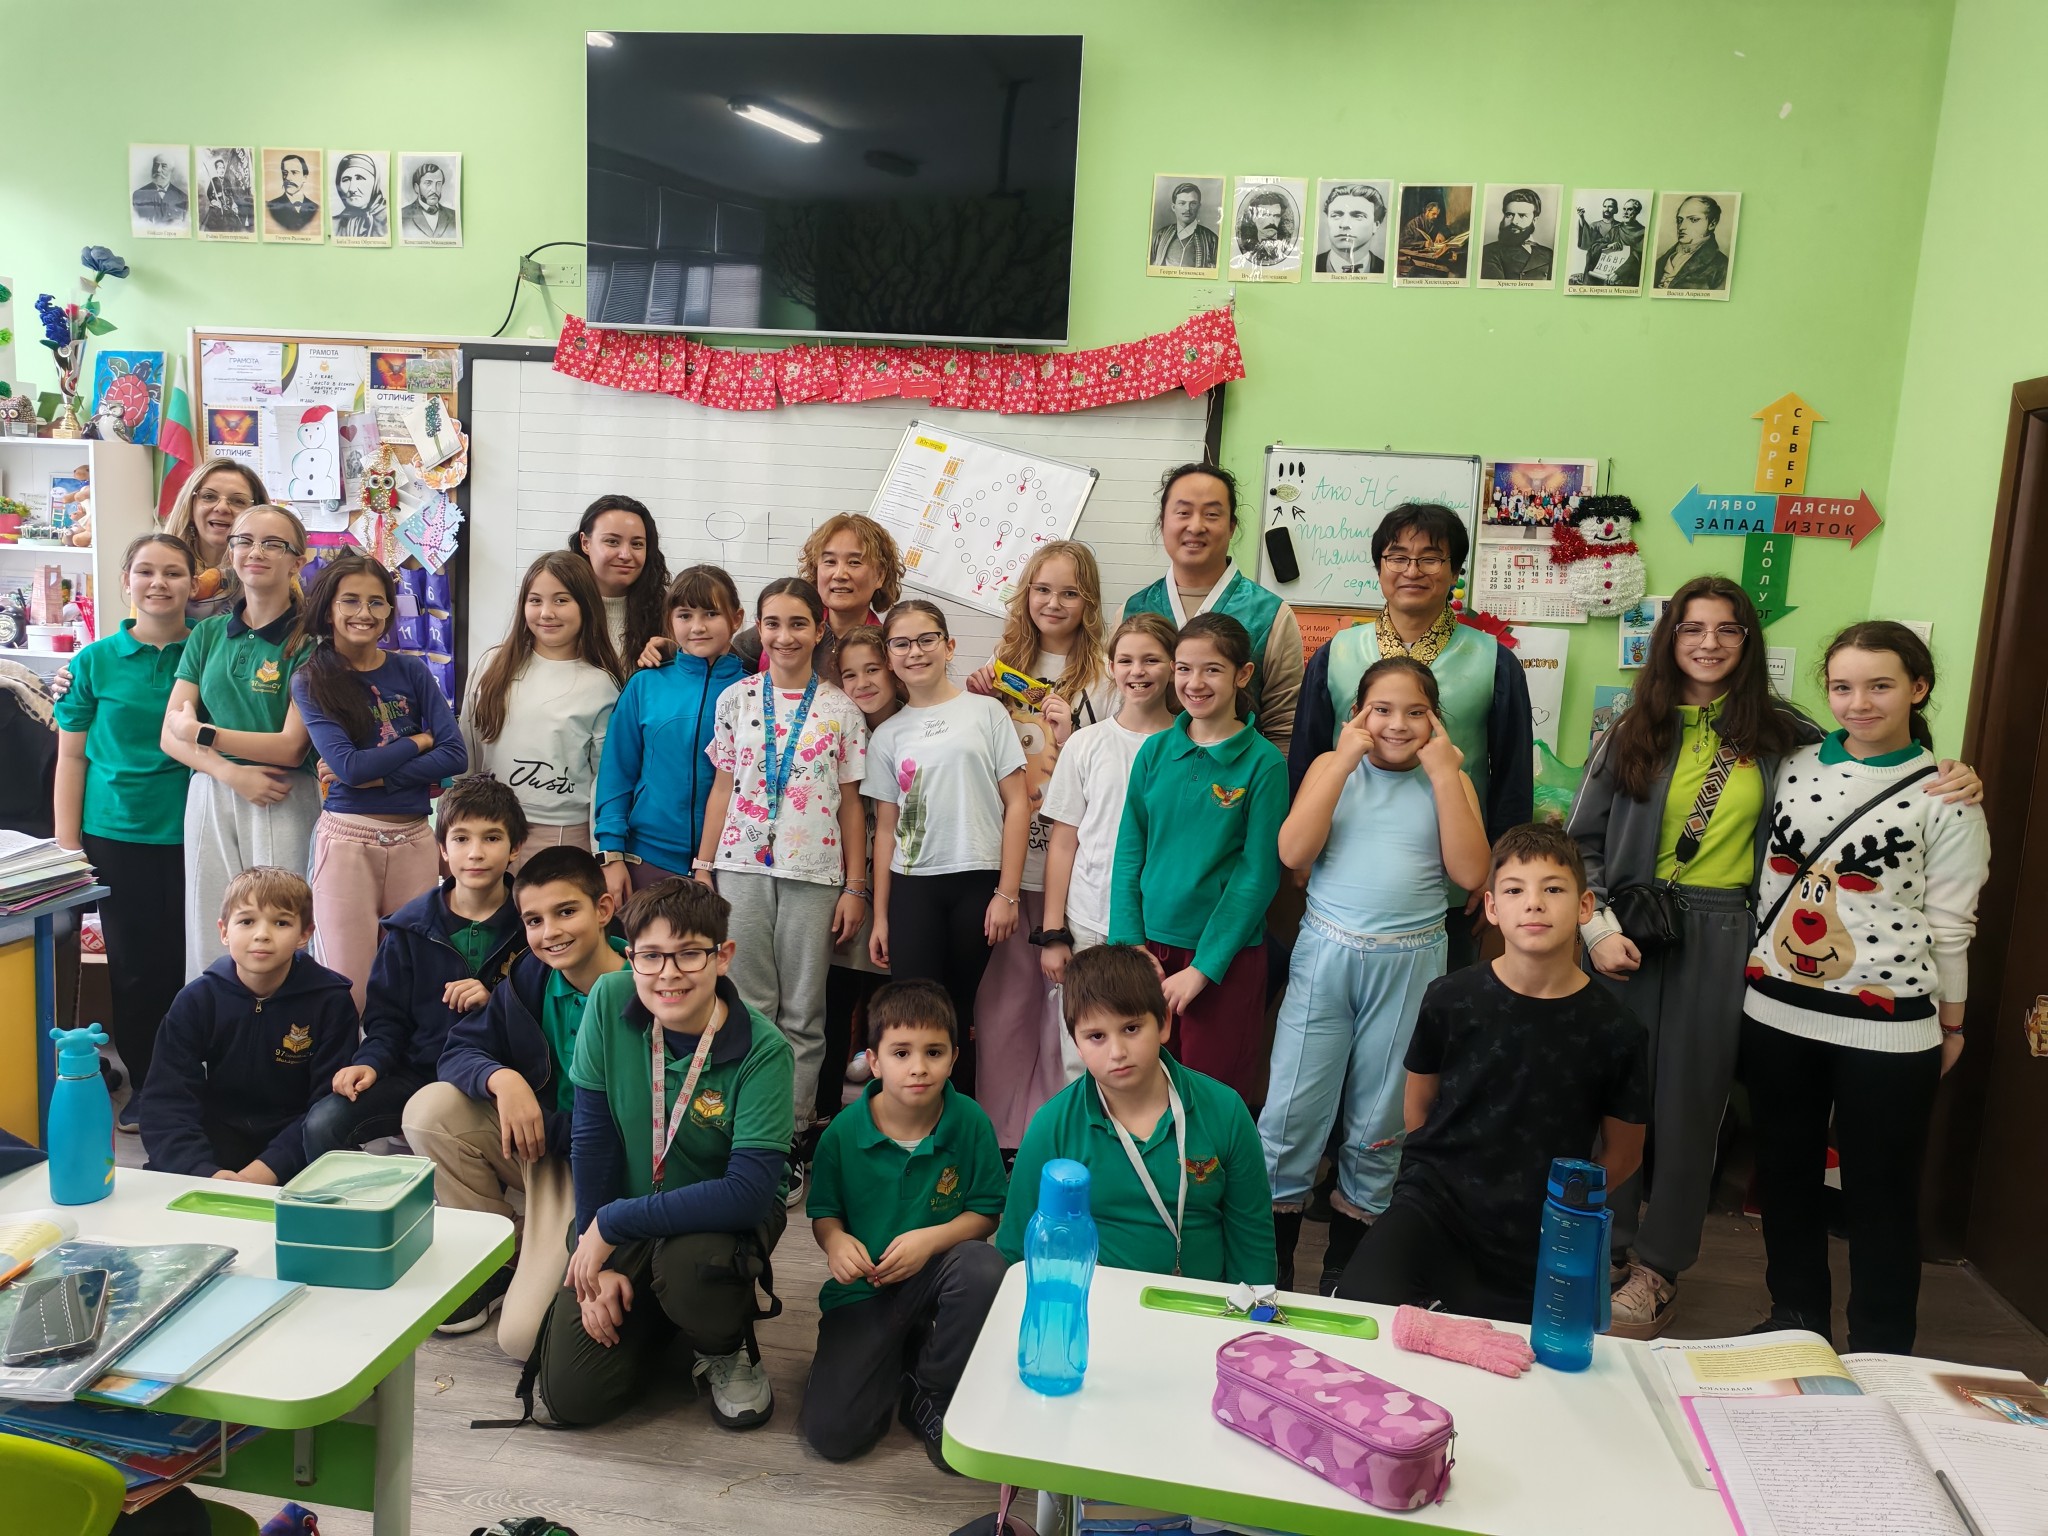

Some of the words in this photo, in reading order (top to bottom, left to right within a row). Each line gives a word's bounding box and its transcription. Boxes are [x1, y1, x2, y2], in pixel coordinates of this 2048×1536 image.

[1614, 287, 1639, 295] Методий
[229, 357, 260, 365] ГРАМОТА
[376, 393, 415, 402] ОТЛИЧИЕ
[214, 448, 253, 457] ОТЛИЧИЕ
[1766, 414, 1782, 480] ГОРЕ
[1785, 407, 1803, 488] СЕВЕР
[1311, 476, 1352, 501] Ако
[1354, 475, 1399, 511] НЕ
[1706, 499, 1757, 511] ЛЯВО
[1789, 501, 1855, 516] ДЯСНО
[1694, 517, 1765, 533] ЗАПАД
[1784, 521, 1856, 536] ИЗТОК
[1758, 540, 1774, 602] ДОЛУ
[404, 582, 413, 595] 5
[1313, 573, 1333, 597] 1
[428, 585, 435, 601] 6
[398, 627, 412, 640] 11
[429, 626, 441, 641] 12
[1314, 625, 1332, 633] МИР,
[275, 1048, 286, 1057] 97
